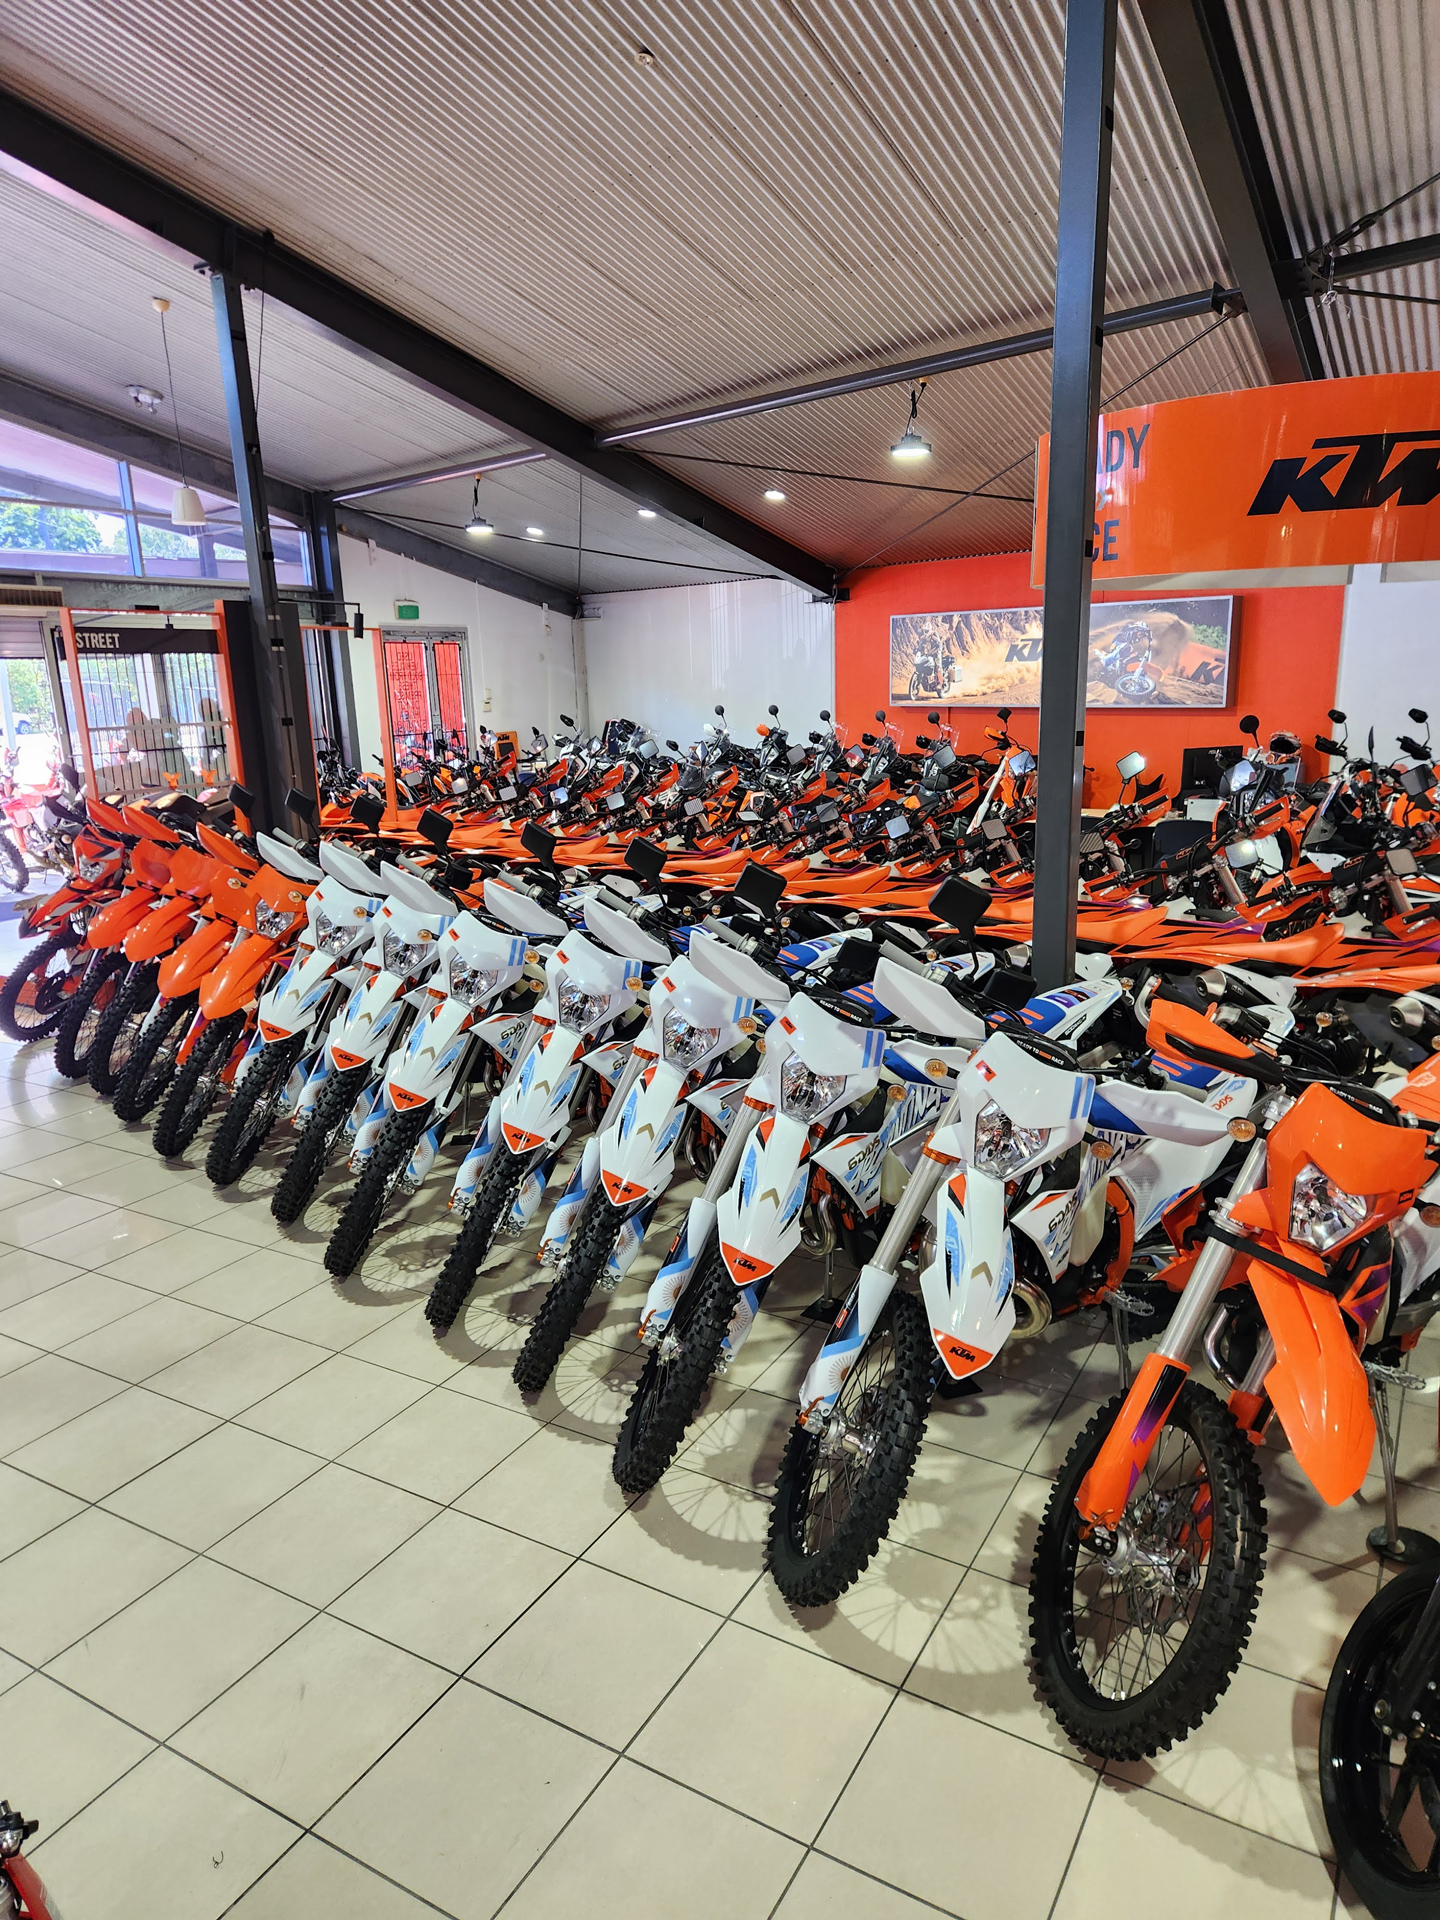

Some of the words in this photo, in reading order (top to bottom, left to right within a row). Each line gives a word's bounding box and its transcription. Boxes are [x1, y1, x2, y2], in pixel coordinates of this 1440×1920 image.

[1247, 430, 1440, 516] KTM
[76, 633, 120, 648] STREET
[265, 1026, 281, 1035] KTM
[338, 1053, 354, 1063] KTM
[1016, 1040, 1032, 1051] READY
[1051, 1056, 1064, 1066] RACE
[396, 1092, 414, 1103] KTM
[733, 1258, 757, 1272] KTM
[949, 1346, 976, 1363] KTM
